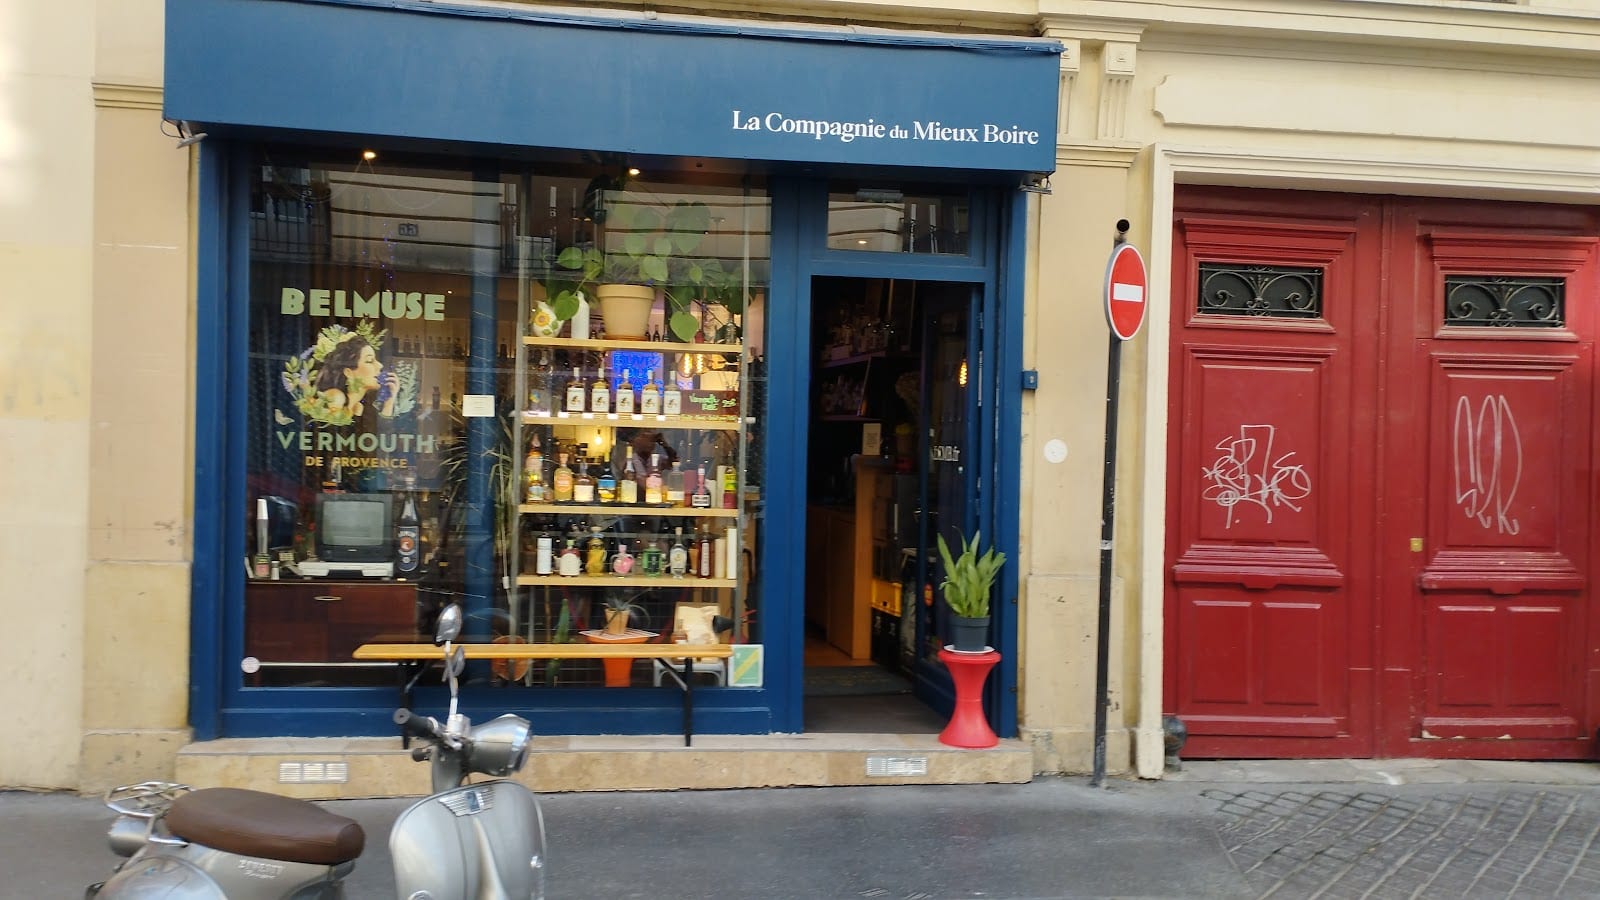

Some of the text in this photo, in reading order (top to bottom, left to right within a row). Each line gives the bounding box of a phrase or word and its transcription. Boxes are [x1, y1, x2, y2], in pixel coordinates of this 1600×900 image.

[732, 110, 1039, 145] La Compagnie du Mieux Boire
[280, 287, 446, 321] BELMUSE
[276, 431, 434, 454] VERMOUTH
[305, 456, 408, 469] DE PROVENCE
